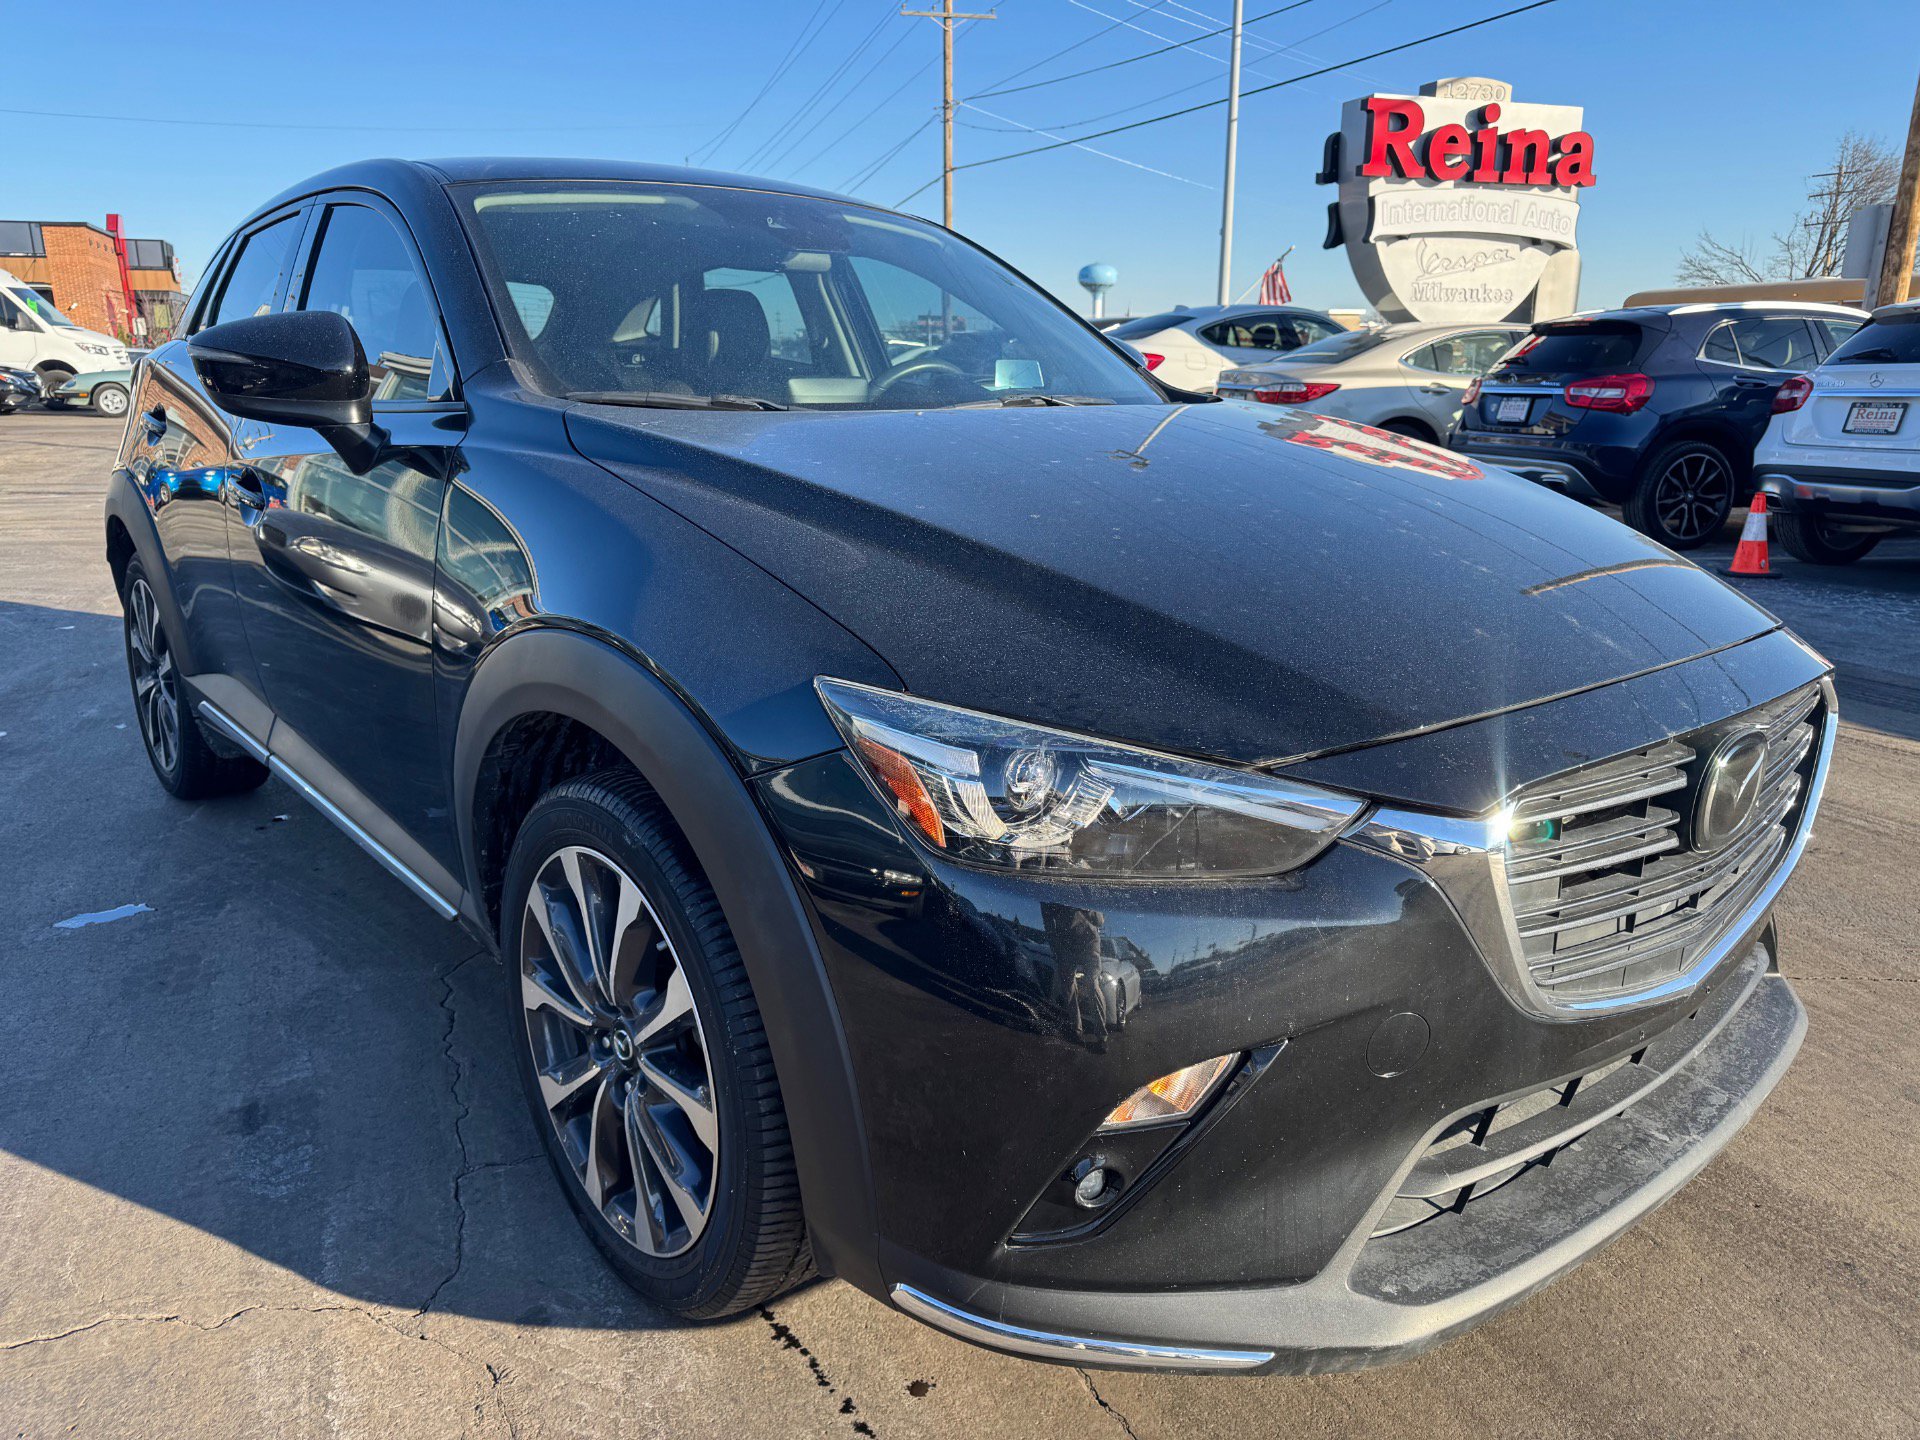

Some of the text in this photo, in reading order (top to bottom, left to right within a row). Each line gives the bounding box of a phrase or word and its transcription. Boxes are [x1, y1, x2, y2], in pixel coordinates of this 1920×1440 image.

[1444, 82, 1506, 102] 12730
[1361, 97, 1597, 187] Reina
[1381, 196, 1572, 235] International Auto
[1416, 237, 1516, 281] Vespa
[1410, 282, 1513, 304] Milwaukee
[1854, 408, 1897, 420] Reina
